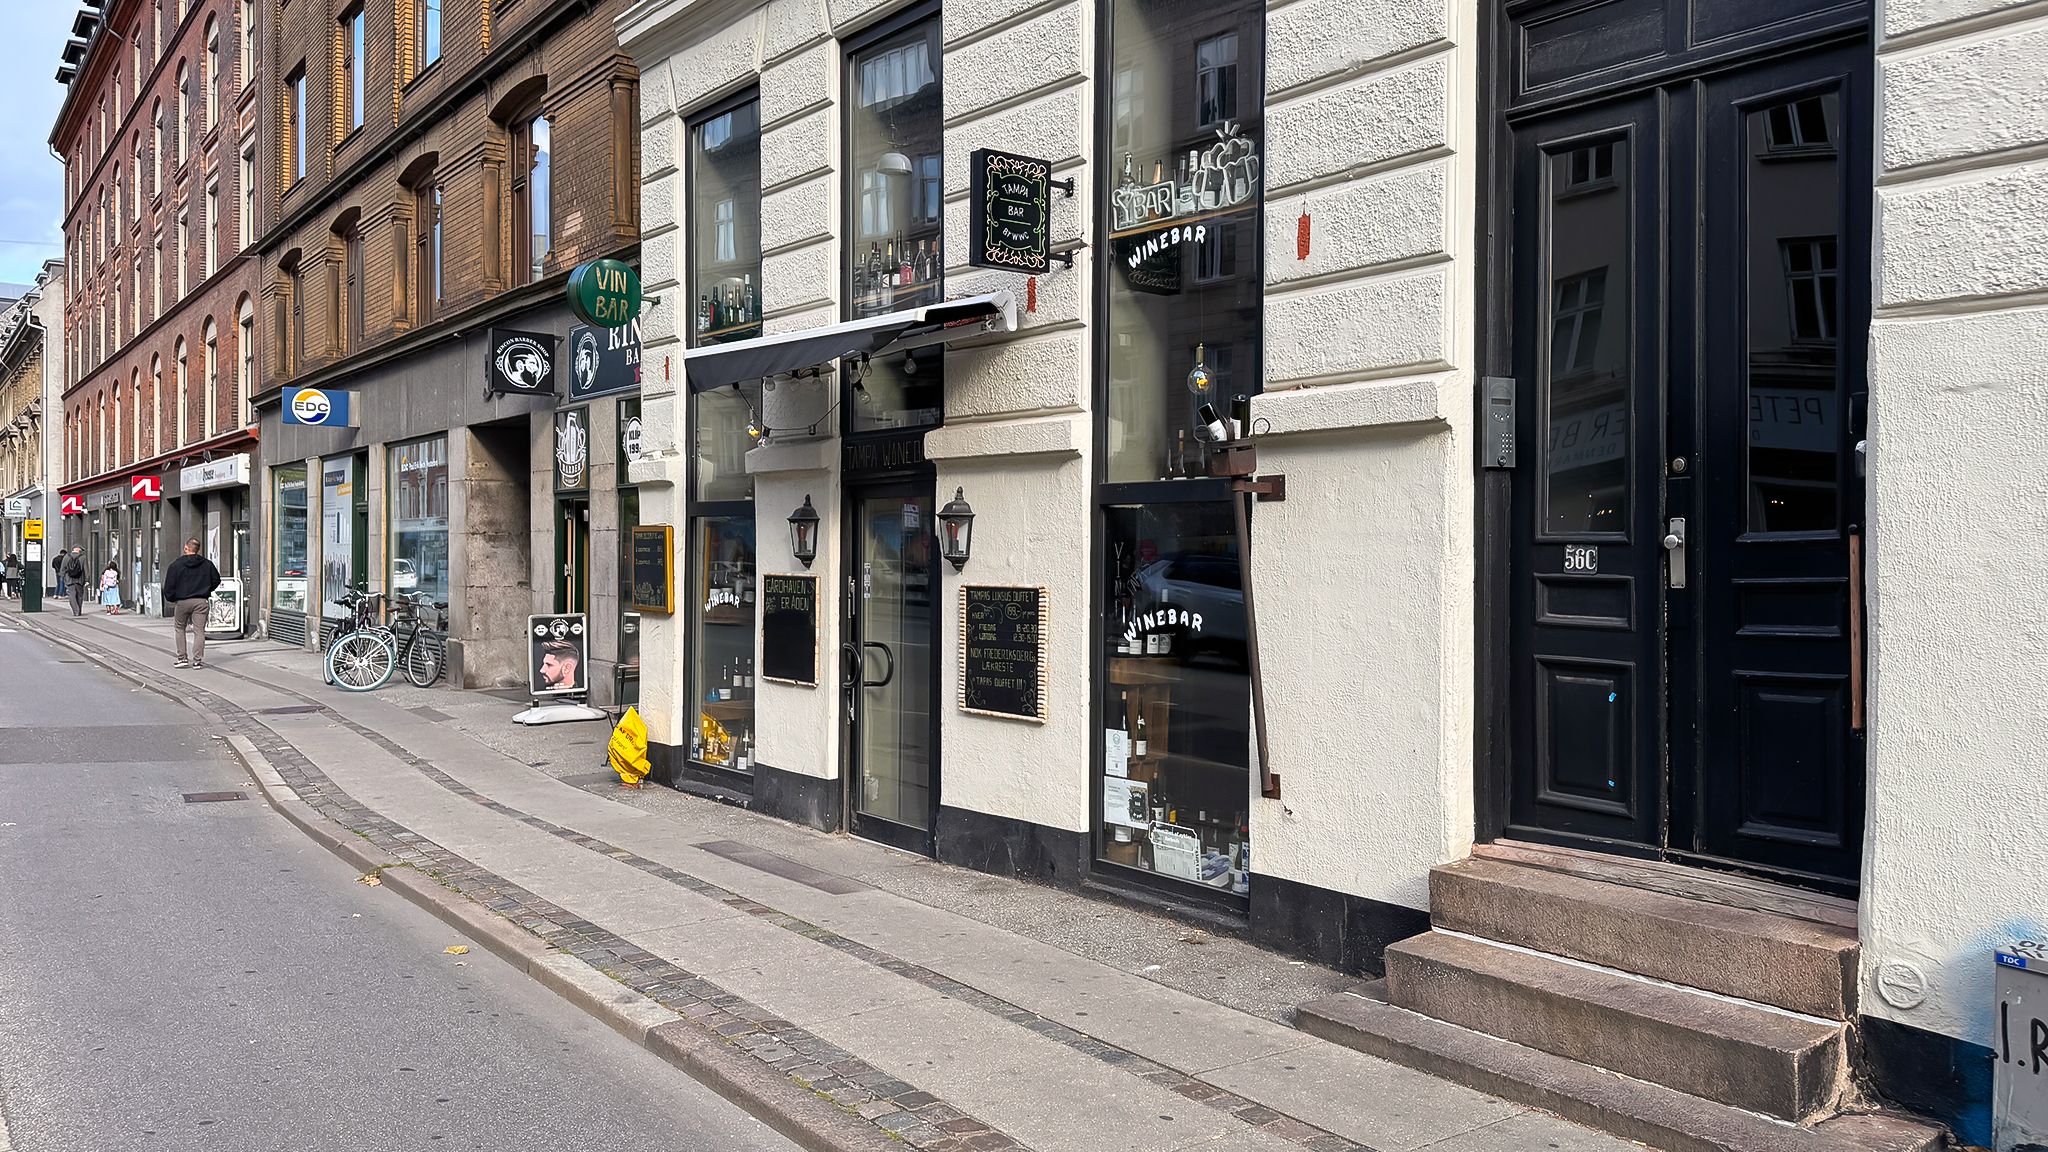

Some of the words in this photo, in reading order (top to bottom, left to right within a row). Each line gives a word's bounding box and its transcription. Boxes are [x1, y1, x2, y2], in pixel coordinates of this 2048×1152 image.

[1001, 183, 1029, 198] TAMPA
[1007, 205, 1024, 218] BAR
[1134, 187, 1172, 220] BAR
[1128, 225, 1206, 269] WINEBAR
[595, 266, 627, 294] VIN
[595, 295, 629, 322] BAR
[514, 336, 538, 347] BARBER
[537, 343, 550, 358] SHOP
[294, 401, 329, 412] EDC
[846, 444, 878, 470] TAMPA
[1564, 546, 1597, 570] 56C
[704, 591, 741, 614] WINEBAR
[1123, 608, 1203, 643] WINEBAR
[2002, 955, 2020, 965] TDC
